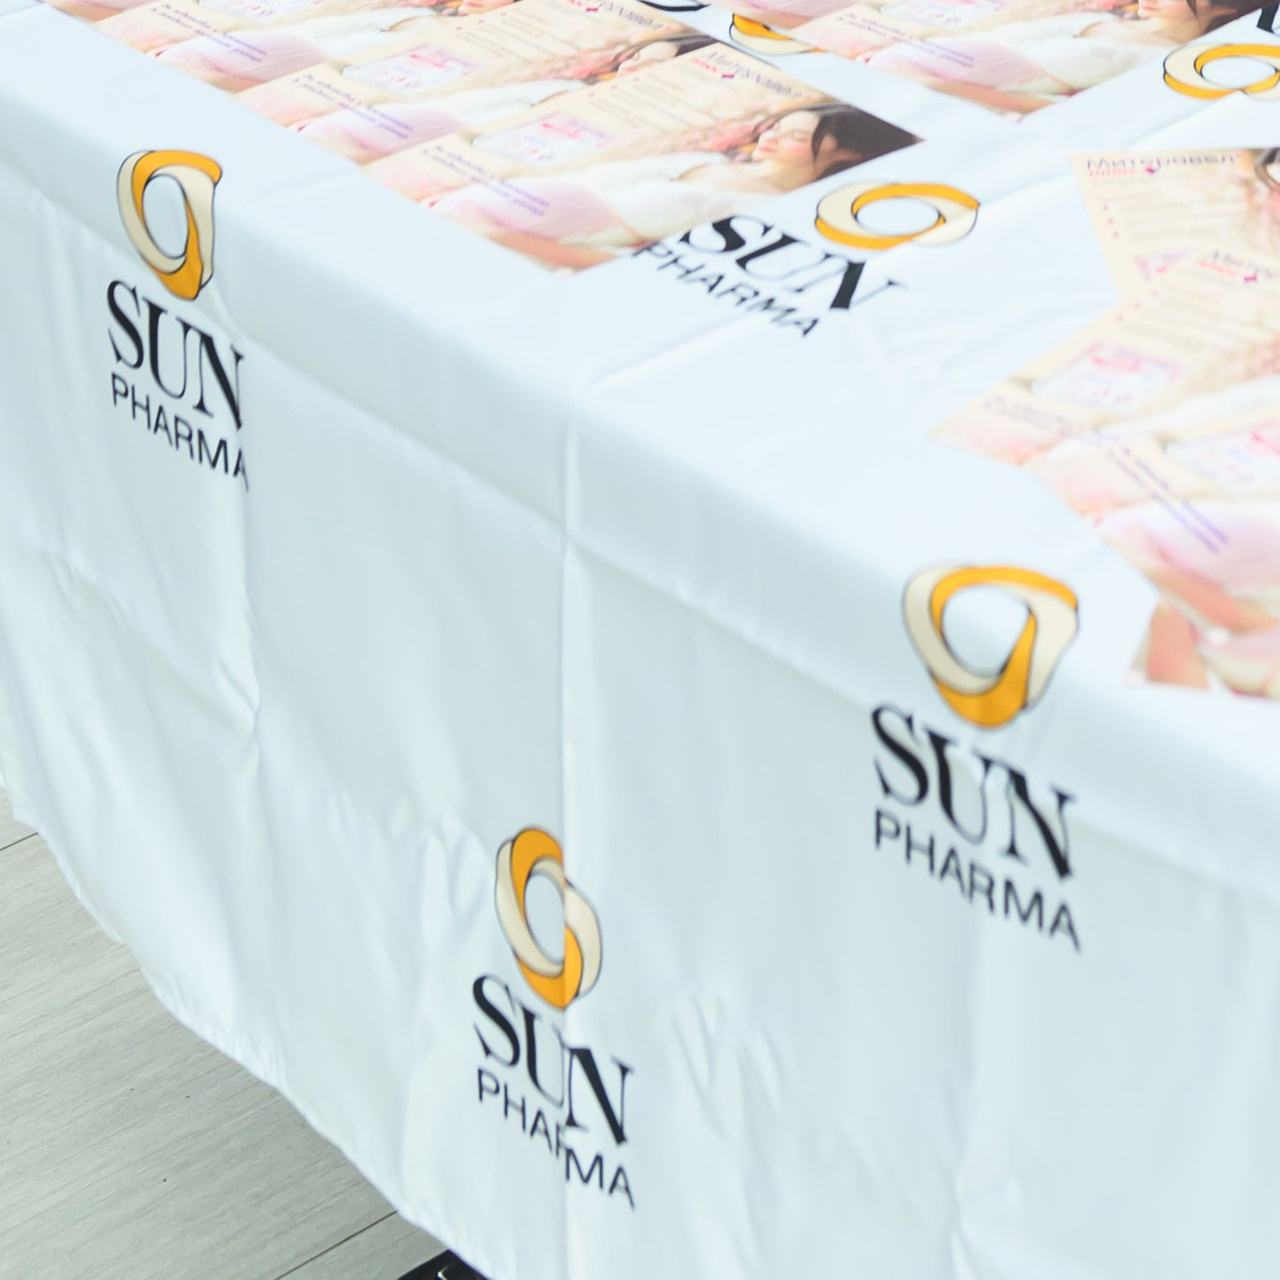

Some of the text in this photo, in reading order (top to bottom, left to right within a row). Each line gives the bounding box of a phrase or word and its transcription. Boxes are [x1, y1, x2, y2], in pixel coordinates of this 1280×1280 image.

[632, 240, 819, 337] PHARMA
[678, 214, 908, 311] SUN
[105, 277, 244, 432] SUN
[111, 370, 249, 491] PHARMA
[871, 704, 1074, 880] SUN
[873, 809, 1080, 953] PHARMA
[472, 972, 635, 1147] SUN
